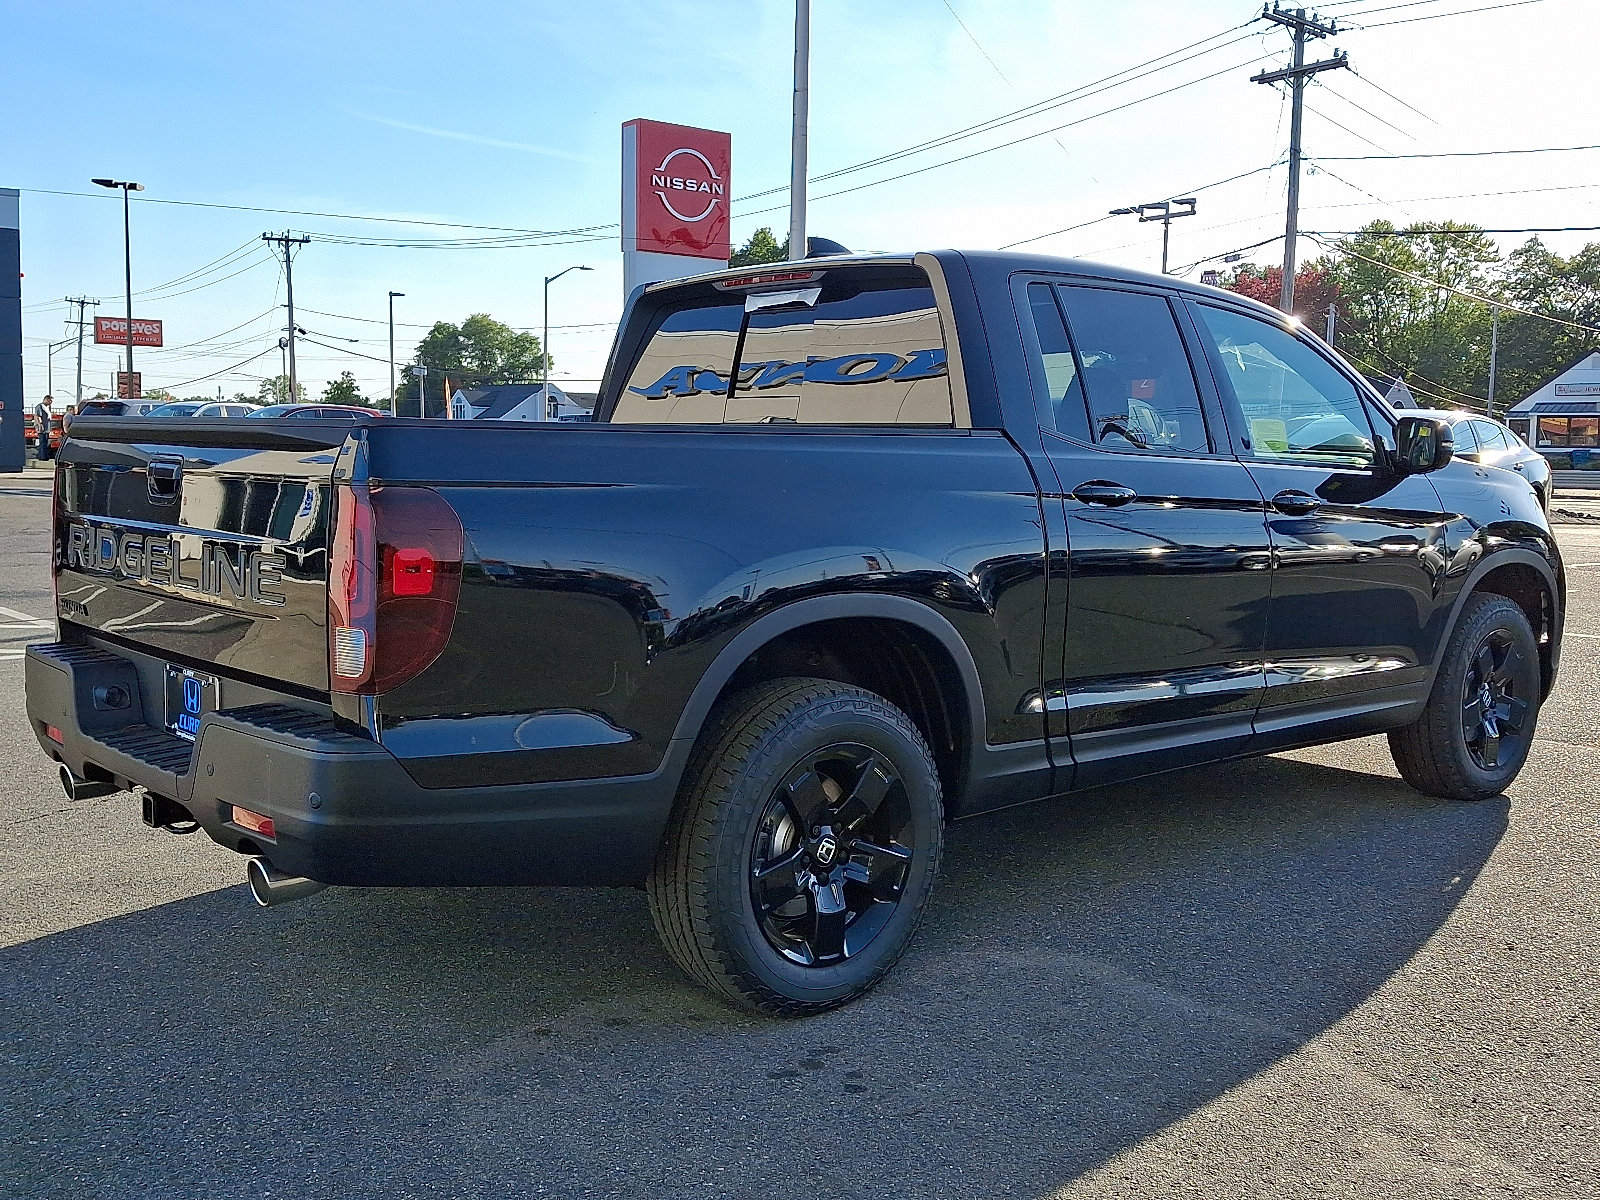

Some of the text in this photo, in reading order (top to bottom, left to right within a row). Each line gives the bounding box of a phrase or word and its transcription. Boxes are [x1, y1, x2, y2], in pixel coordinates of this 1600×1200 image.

[652, 174, 723, 195] NISSAN
[69, 523, 287, 607] RIDGELINE
[179, 713, 201, 733] CURR
